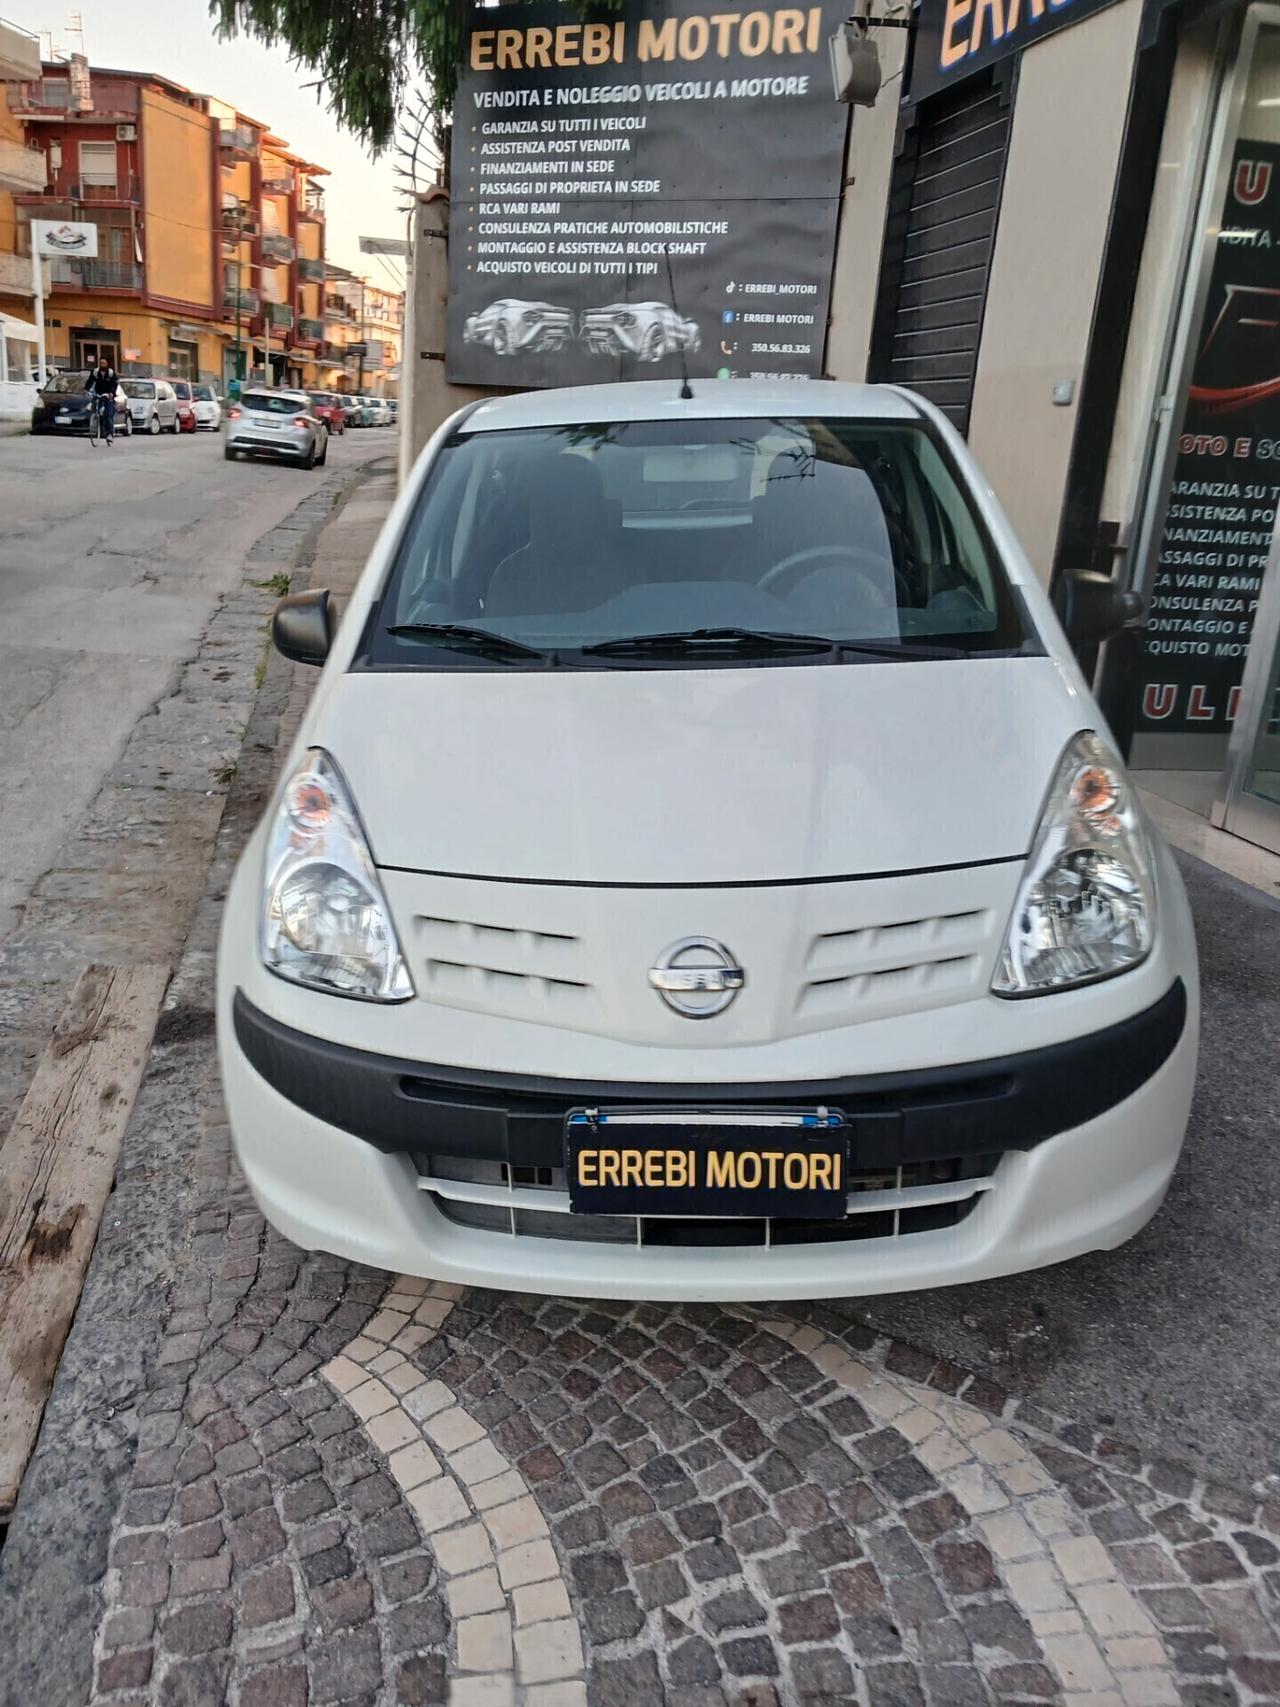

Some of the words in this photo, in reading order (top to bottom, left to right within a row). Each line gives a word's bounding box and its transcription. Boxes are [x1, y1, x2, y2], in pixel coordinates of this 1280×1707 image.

[469, 22, 625, 71] ERREBI
[637, 7, 822, 62] MOTORI
[474, 89, 540, 108] VENDITA
[544, 89, 553, 105] E
[557, 84, 642, 105] NOLEGGIO
[645, 81, 712, 101] VEICOLI
[713, 80, 727, 98] A
[730, 75, 810, 97] MOTORE
[482, 120, 538, 134] GARANZIA
[541, 119, 556, 132] SU
[558, 118, 591, 132] TUTTI
[600, 116, 647, 130] VEICOLI
[481, 141, 545, 154] ASSISTENZA
[549, 140, 577, 153] POST
[579, 139, 631, 152] VENDITA
[480, 161, 569, 175] FINANZIAMENTI
[571, 161, 584, 173] IN
[586, 160, 616, 173] SEDE
[479, 182, 532, 195] PASSAGGI
[535, 182, 547, 194] DI
[550, 181, 613, 194] PROPRIETA
[615, 180, 628, 193] IN
[630, 180, 661, 193] SEDE
[479, 203, 501, 214] RCA
[503, 202, 528, 214] VARI
[531, 202, 560, 214] RAMI
[478, 222, 551, 234] CONSULENZA
[553, 222, 609, 234] PRATICHE
[610, 221, 728, 234] AUTOMOBILISTICHE
[478, 242, 546, 253] MONTAGGIO
[548, 242, 555, 253] E
[557, 242, 624, 254] ASSISTENZA
[626, 242, 666, 254] BLOCK
[668, 242, 707, 255] SHAFT
[476, 261, 532, 275] ACQUISTO
[534, 262, 576, 274] VEICOLI
[579, 262, 591, 274] DI
[593, 262, 626, 274] TUTTI
[635, 262, 658, 274] TIPI
[743, 313, 775, 323] ERREBI
[776, 314, 814, 324] MOTORI
[751, 343, 811, 354] 350.56.83.326
[1233, 437, 1252, 458] E
[1243, 485, 1266, 499] SU
[1159, 551, 1223, 566] SSAGGI
[1226, 554, 1244, 567] DI
[1176, 574, 1213, 589] VARI
[1217, 576, 1260, 590] RAMI
[1238, 622, 1249, 634] E
[1145, 640, 1209, 656] QUISTO
[578, 1149, 696, 1188] ERREBI
[706, 1150, 841, 1190] MOTORI
